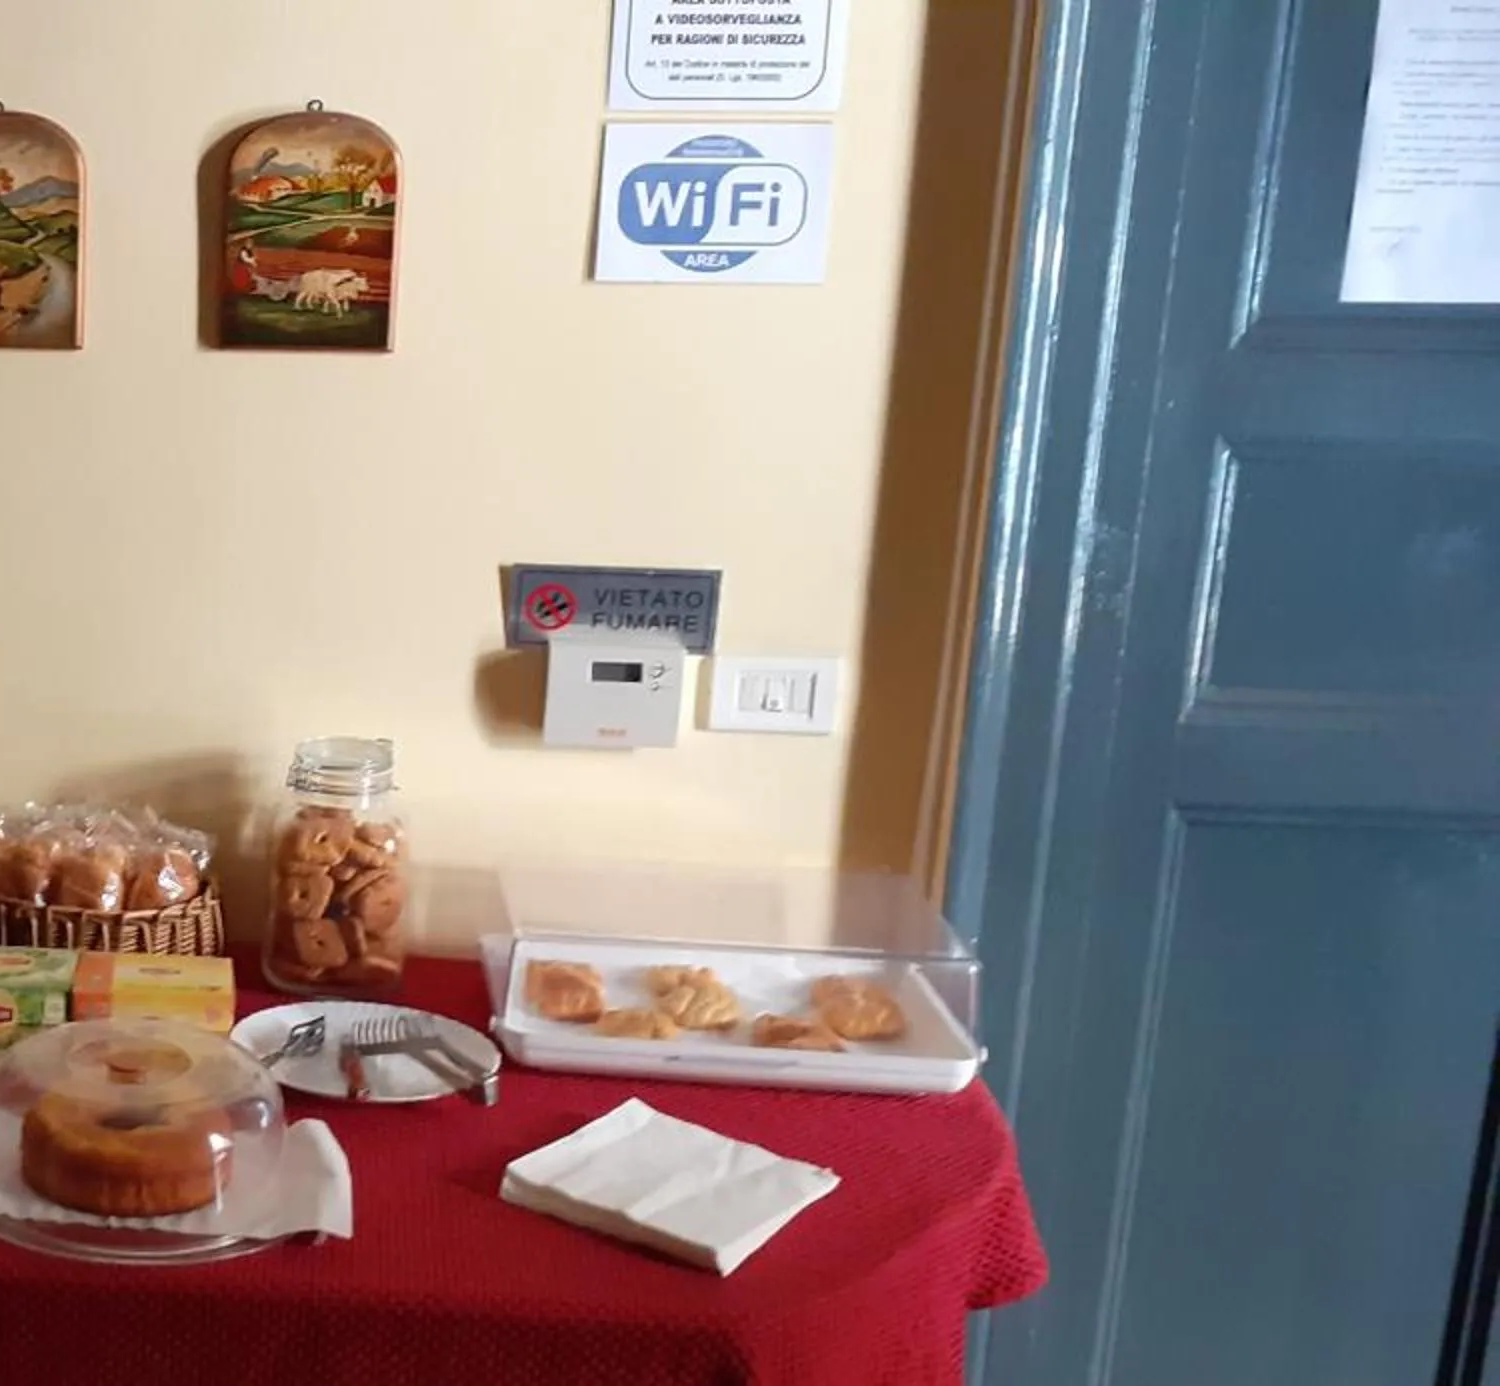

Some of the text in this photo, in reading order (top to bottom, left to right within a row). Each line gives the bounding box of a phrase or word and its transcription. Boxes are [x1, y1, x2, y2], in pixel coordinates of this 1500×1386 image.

[654, 14, 802, 25] A VIDEOSORVEGLIANZA
[651, 34, 806, 45] PER RAGIONI DI SICUREZZA
[683, 253, 730, 267] AREA
[593, 588, 704, 609] VIETATO
[590, 612, 699, 633] FUMARE
